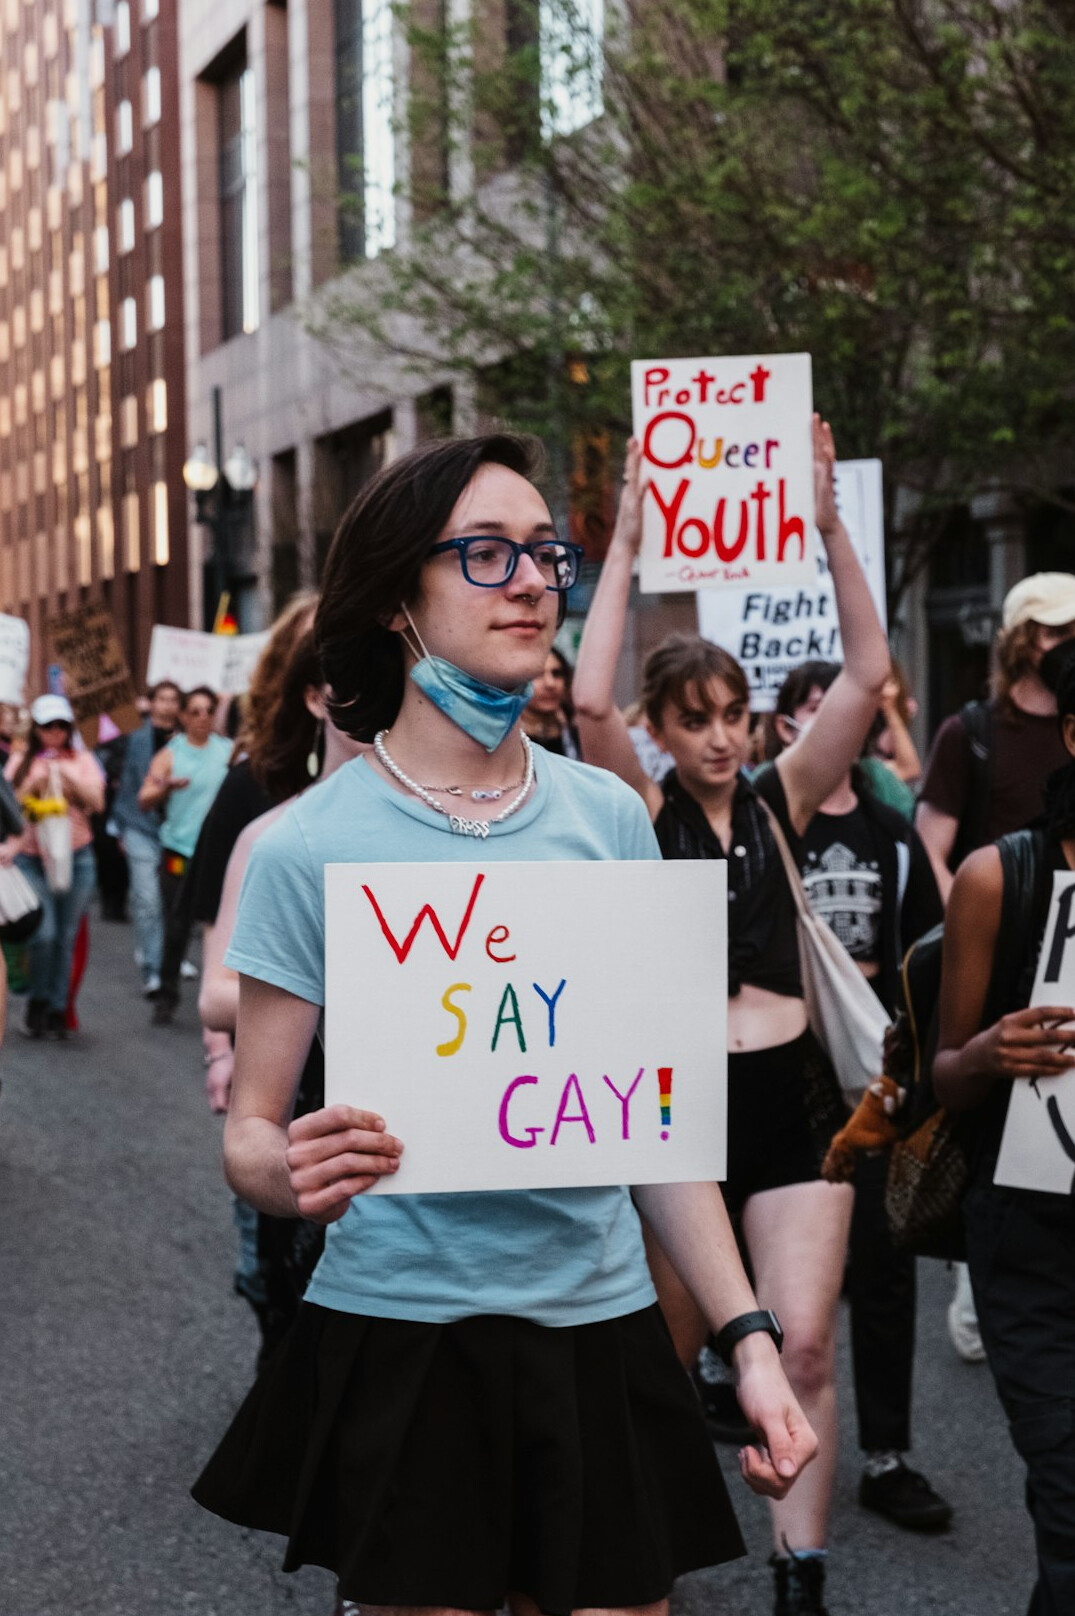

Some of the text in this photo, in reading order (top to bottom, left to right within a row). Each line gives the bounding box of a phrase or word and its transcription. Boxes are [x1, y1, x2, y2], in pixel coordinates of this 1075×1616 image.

[644, 365, 770, 406] Protect
[643, 411, 779, 470] Queer
[743, 592, 827, 624] Fight
[740, 629, 836, 660] Back!
[361, 873, 516, 964] We
[436, 979, 566, 1057] SAY
[498, 1067, 673, 1149] GAY!
